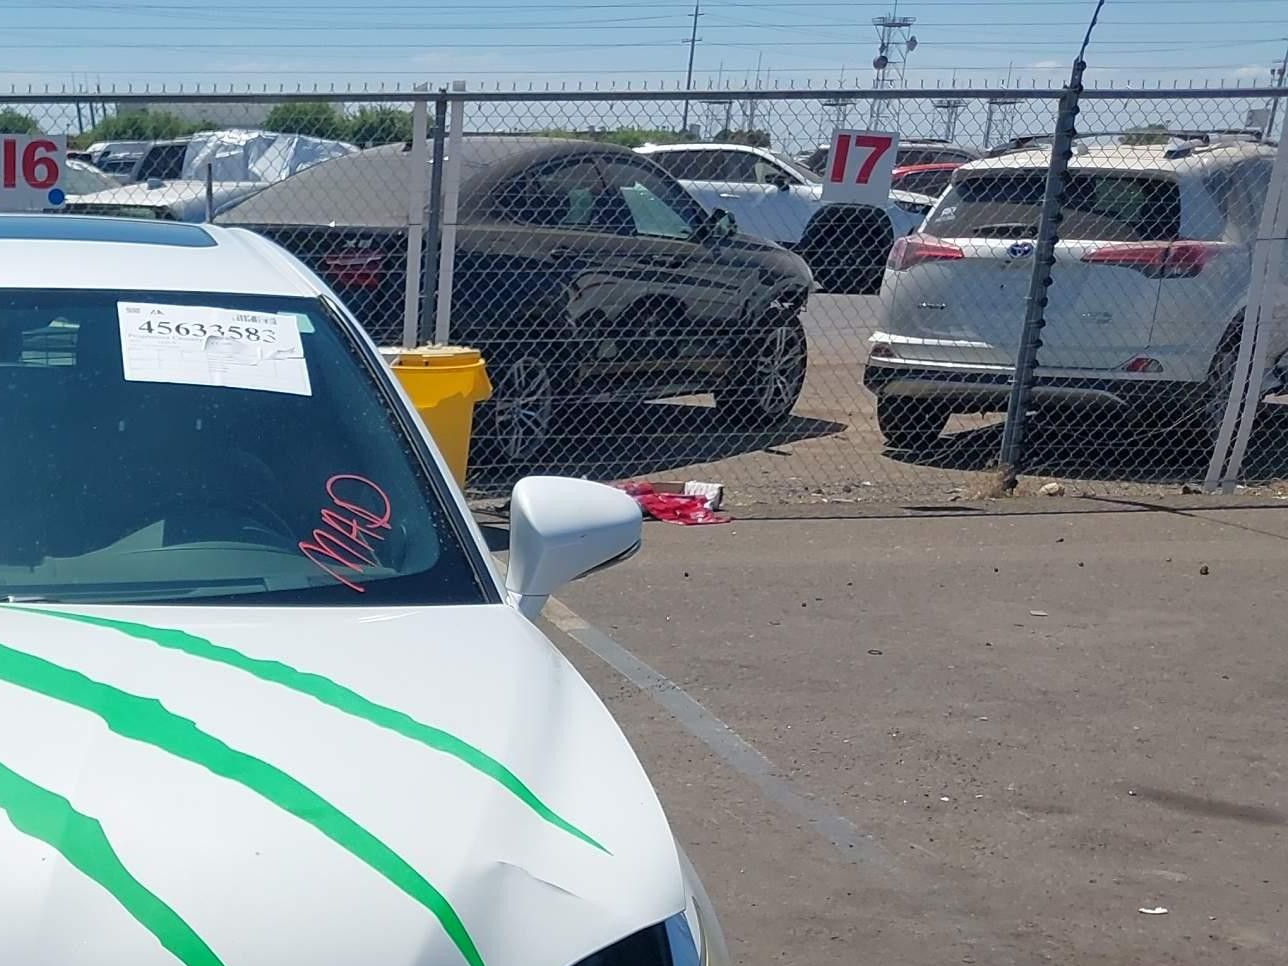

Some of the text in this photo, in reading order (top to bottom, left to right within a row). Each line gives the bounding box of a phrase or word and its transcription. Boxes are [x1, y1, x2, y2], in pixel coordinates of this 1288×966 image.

[3, 139, 59, 189] 16
[830, 134, 893, 185] 17
[138, 319, 277, 344] 45633583
